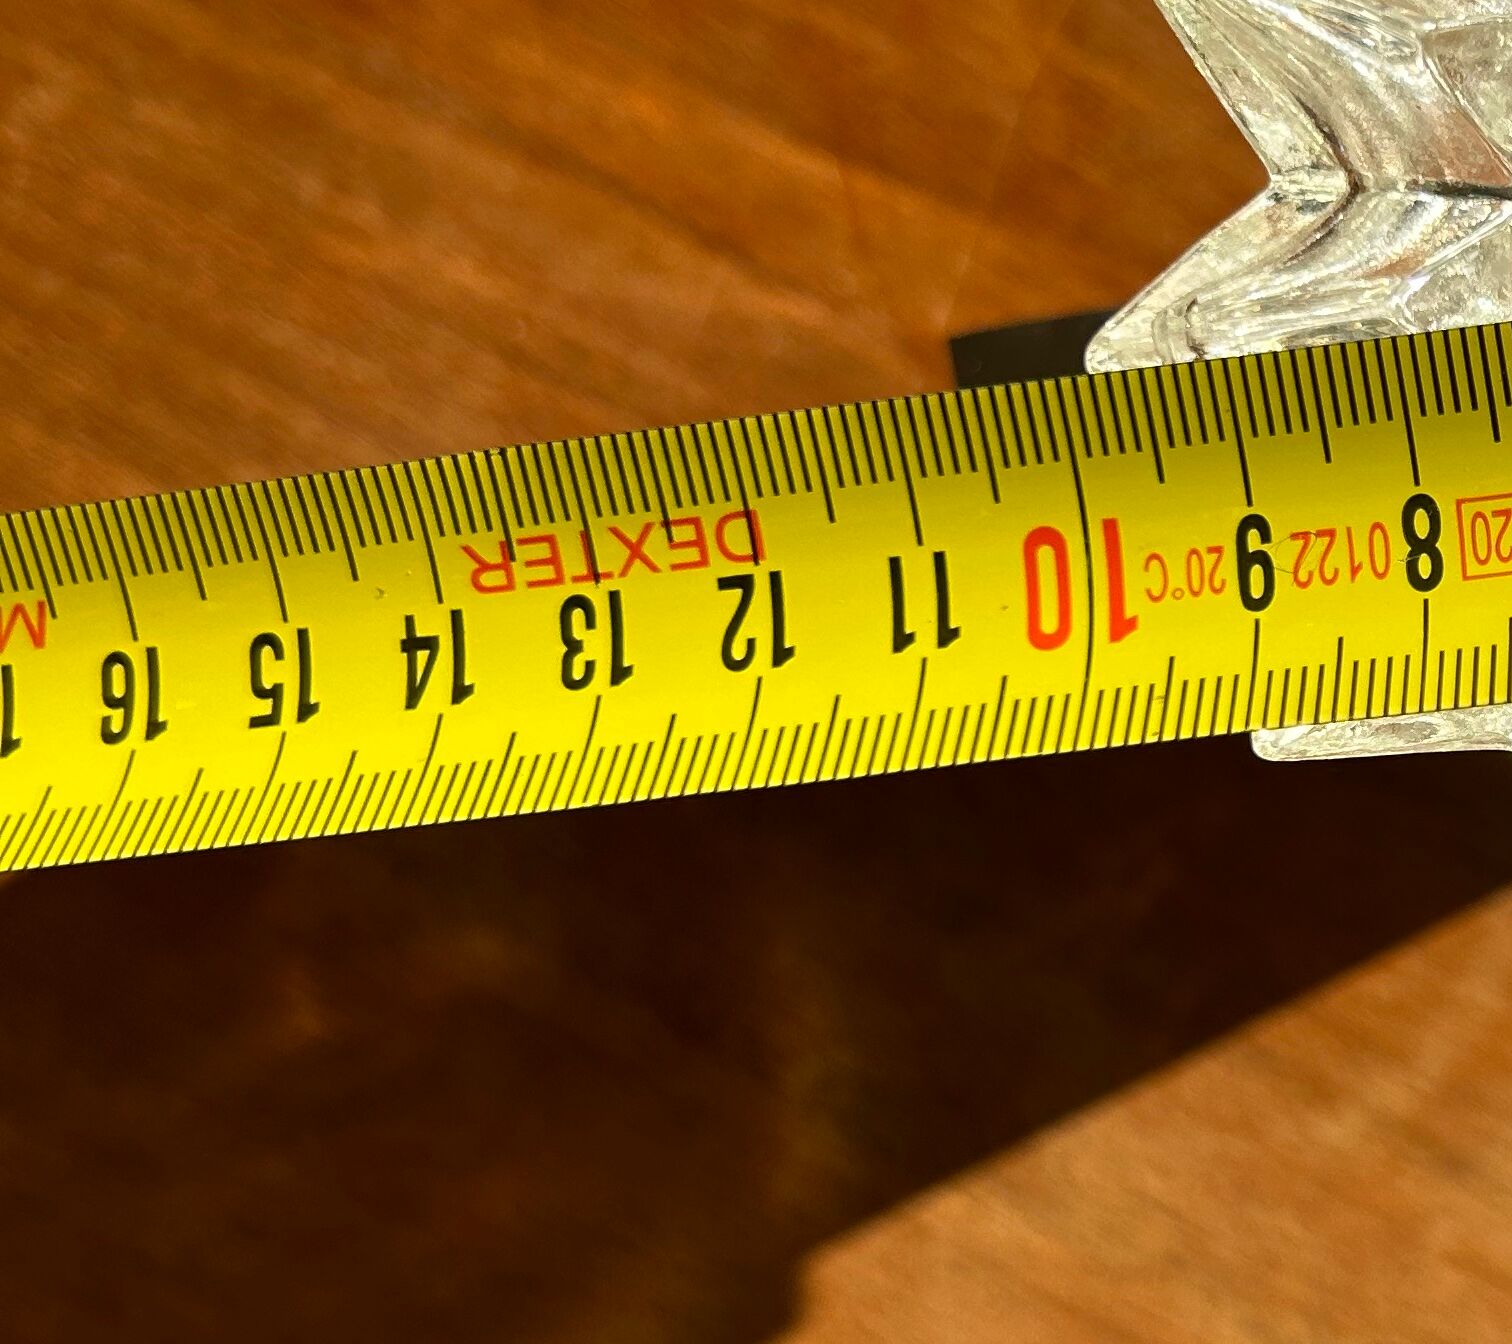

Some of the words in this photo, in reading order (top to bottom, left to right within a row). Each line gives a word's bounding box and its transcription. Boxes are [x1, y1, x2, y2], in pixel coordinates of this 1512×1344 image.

[461, 509, 766, 595] DEXTER
[1022, 517, 1139, 651] 10
[1235, 513, 1275, 612] 9
[1290, 521, 1391, 589] 0122
[1401, 493, 1444, 592] 8
[559, 589, 634, 692] 13
[716, 570, 796, 672] 12
[888, 551, 961, 654] 11
[100, 646, 168, 745] 16
[248, 627, 320, 729] 15
[400, 608, 475, 710] 14
